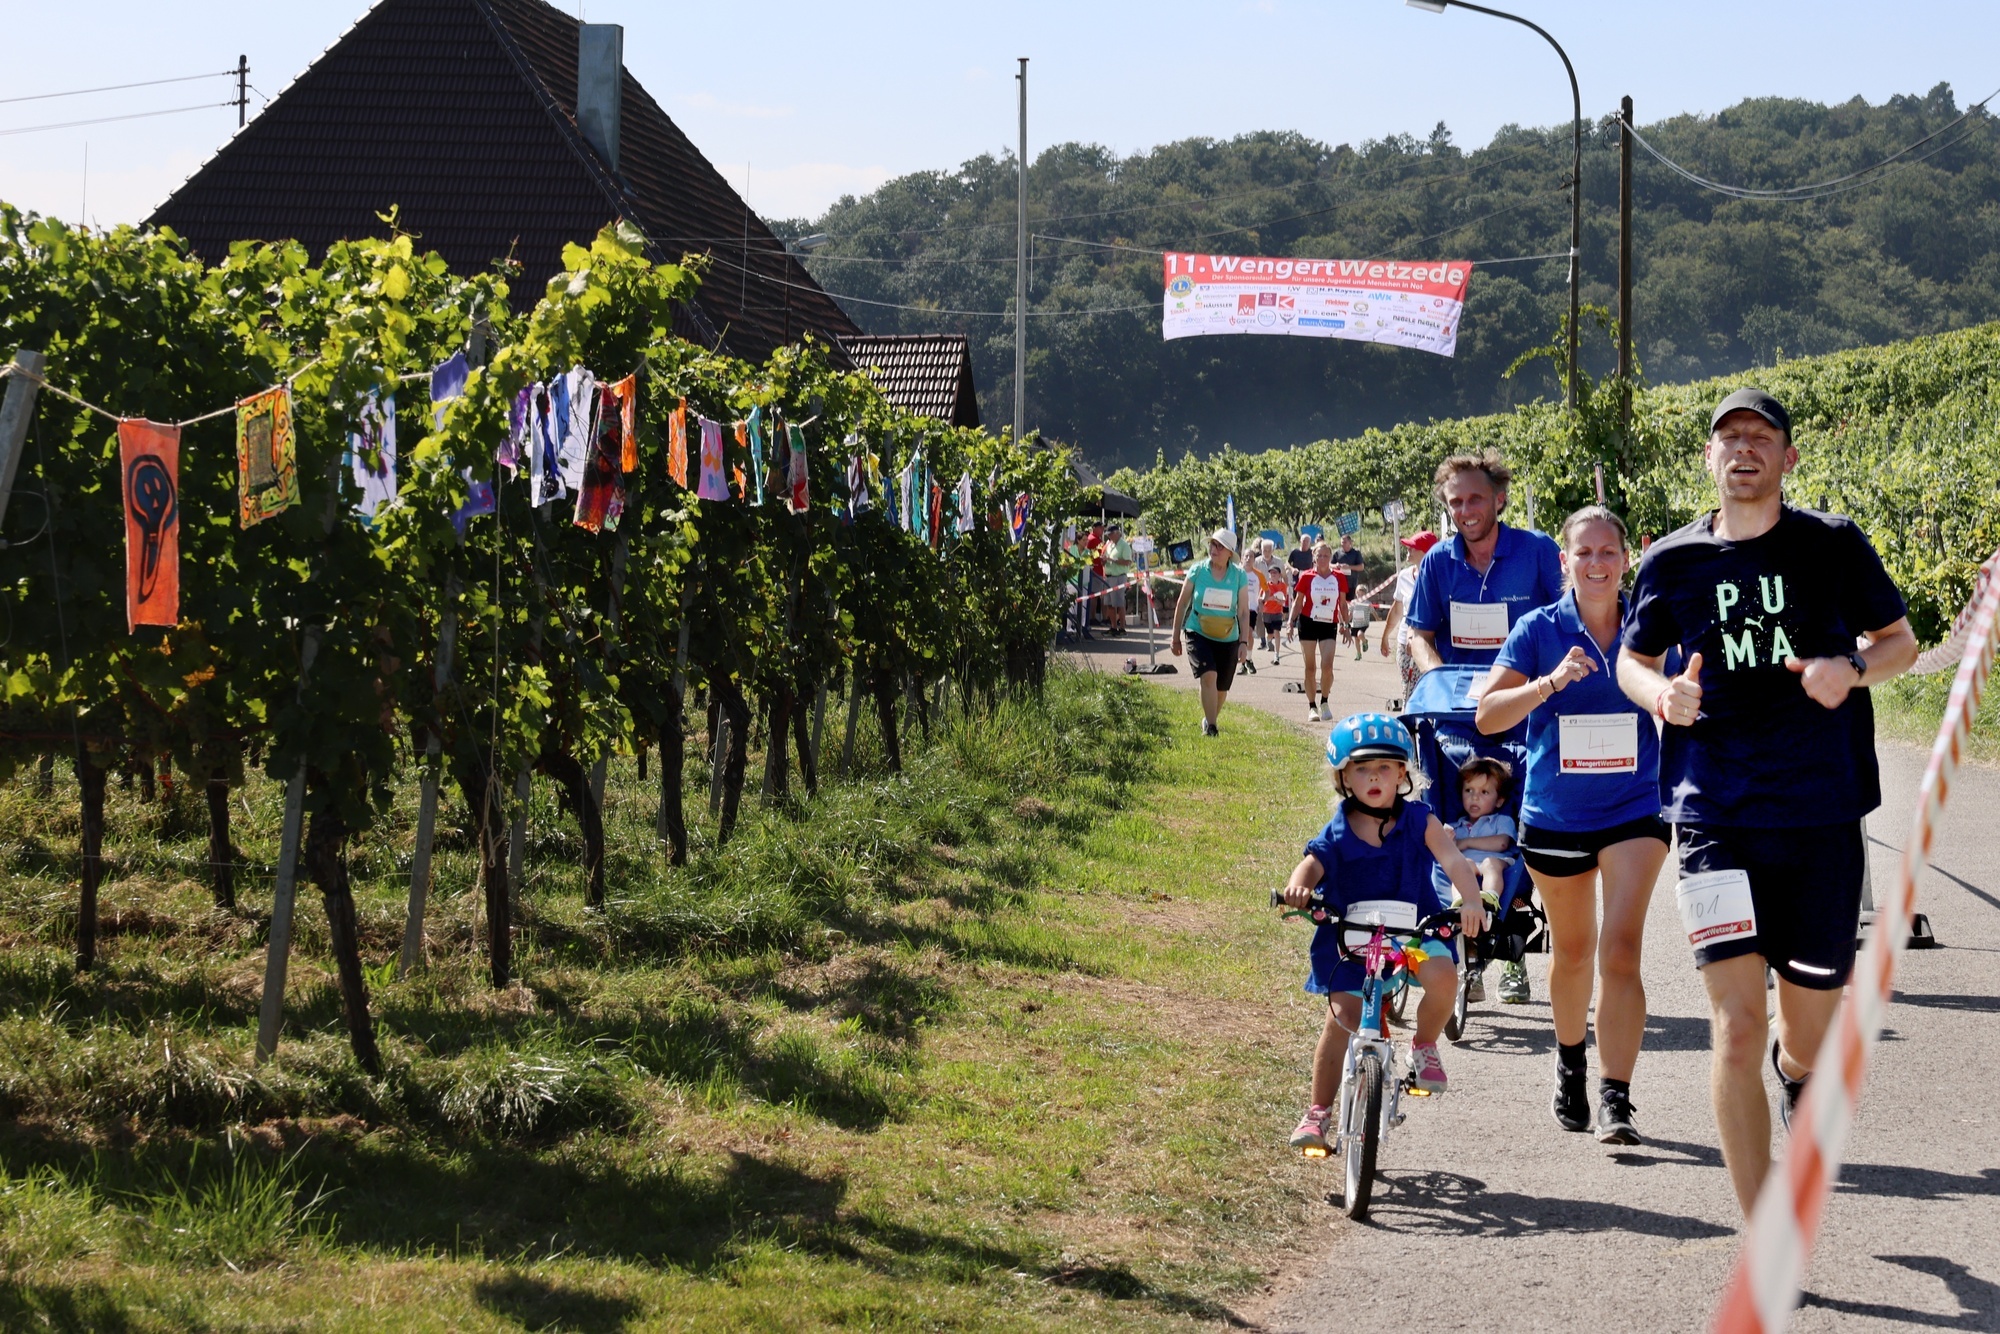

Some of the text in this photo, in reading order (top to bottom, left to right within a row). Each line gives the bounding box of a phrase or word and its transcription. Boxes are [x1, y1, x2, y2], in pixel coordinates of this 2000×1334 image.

[1167, 254, 1206, 274] 11.
[1367, 280, 1400, 288] Menschen
[1470, 616, 1487, 635] 4
[1588, 730, 1615, 755] 4
[1576, 759, 1624, 769] WengertWetzede
[1687, 894, 1720, 920] 101
